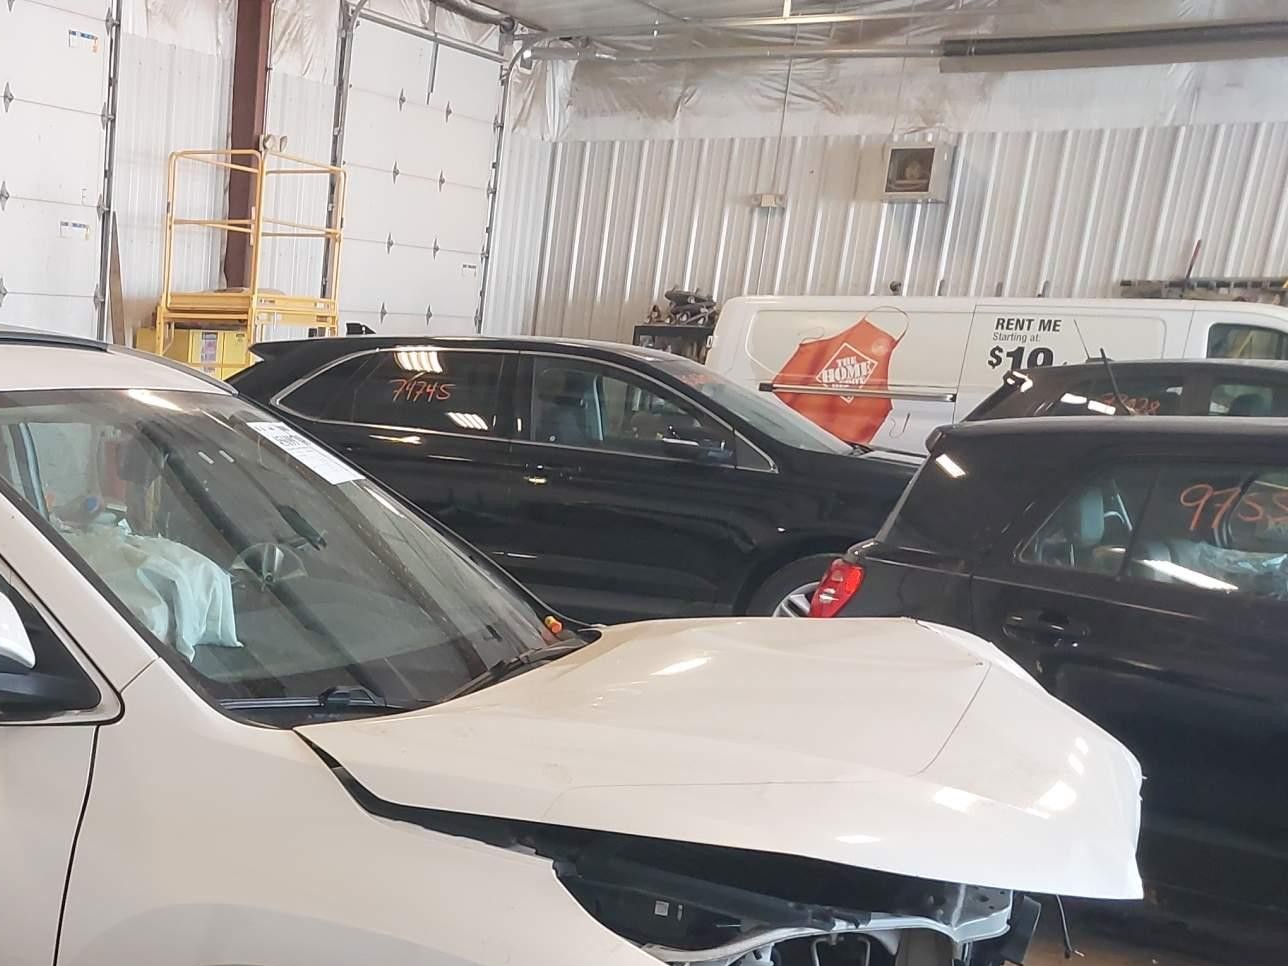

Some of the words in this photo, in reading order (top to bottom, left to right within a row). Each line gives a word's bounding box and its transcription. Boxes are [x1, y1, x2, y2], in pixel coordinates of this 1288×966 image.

[995, 318, 1035, 331] RENT
[1038, 319, 1062, 332] ME
[993, 332, 1027, 343] Starting
[836, 356, 857, 367] THE
[822, 361, 872, 383] HOME
